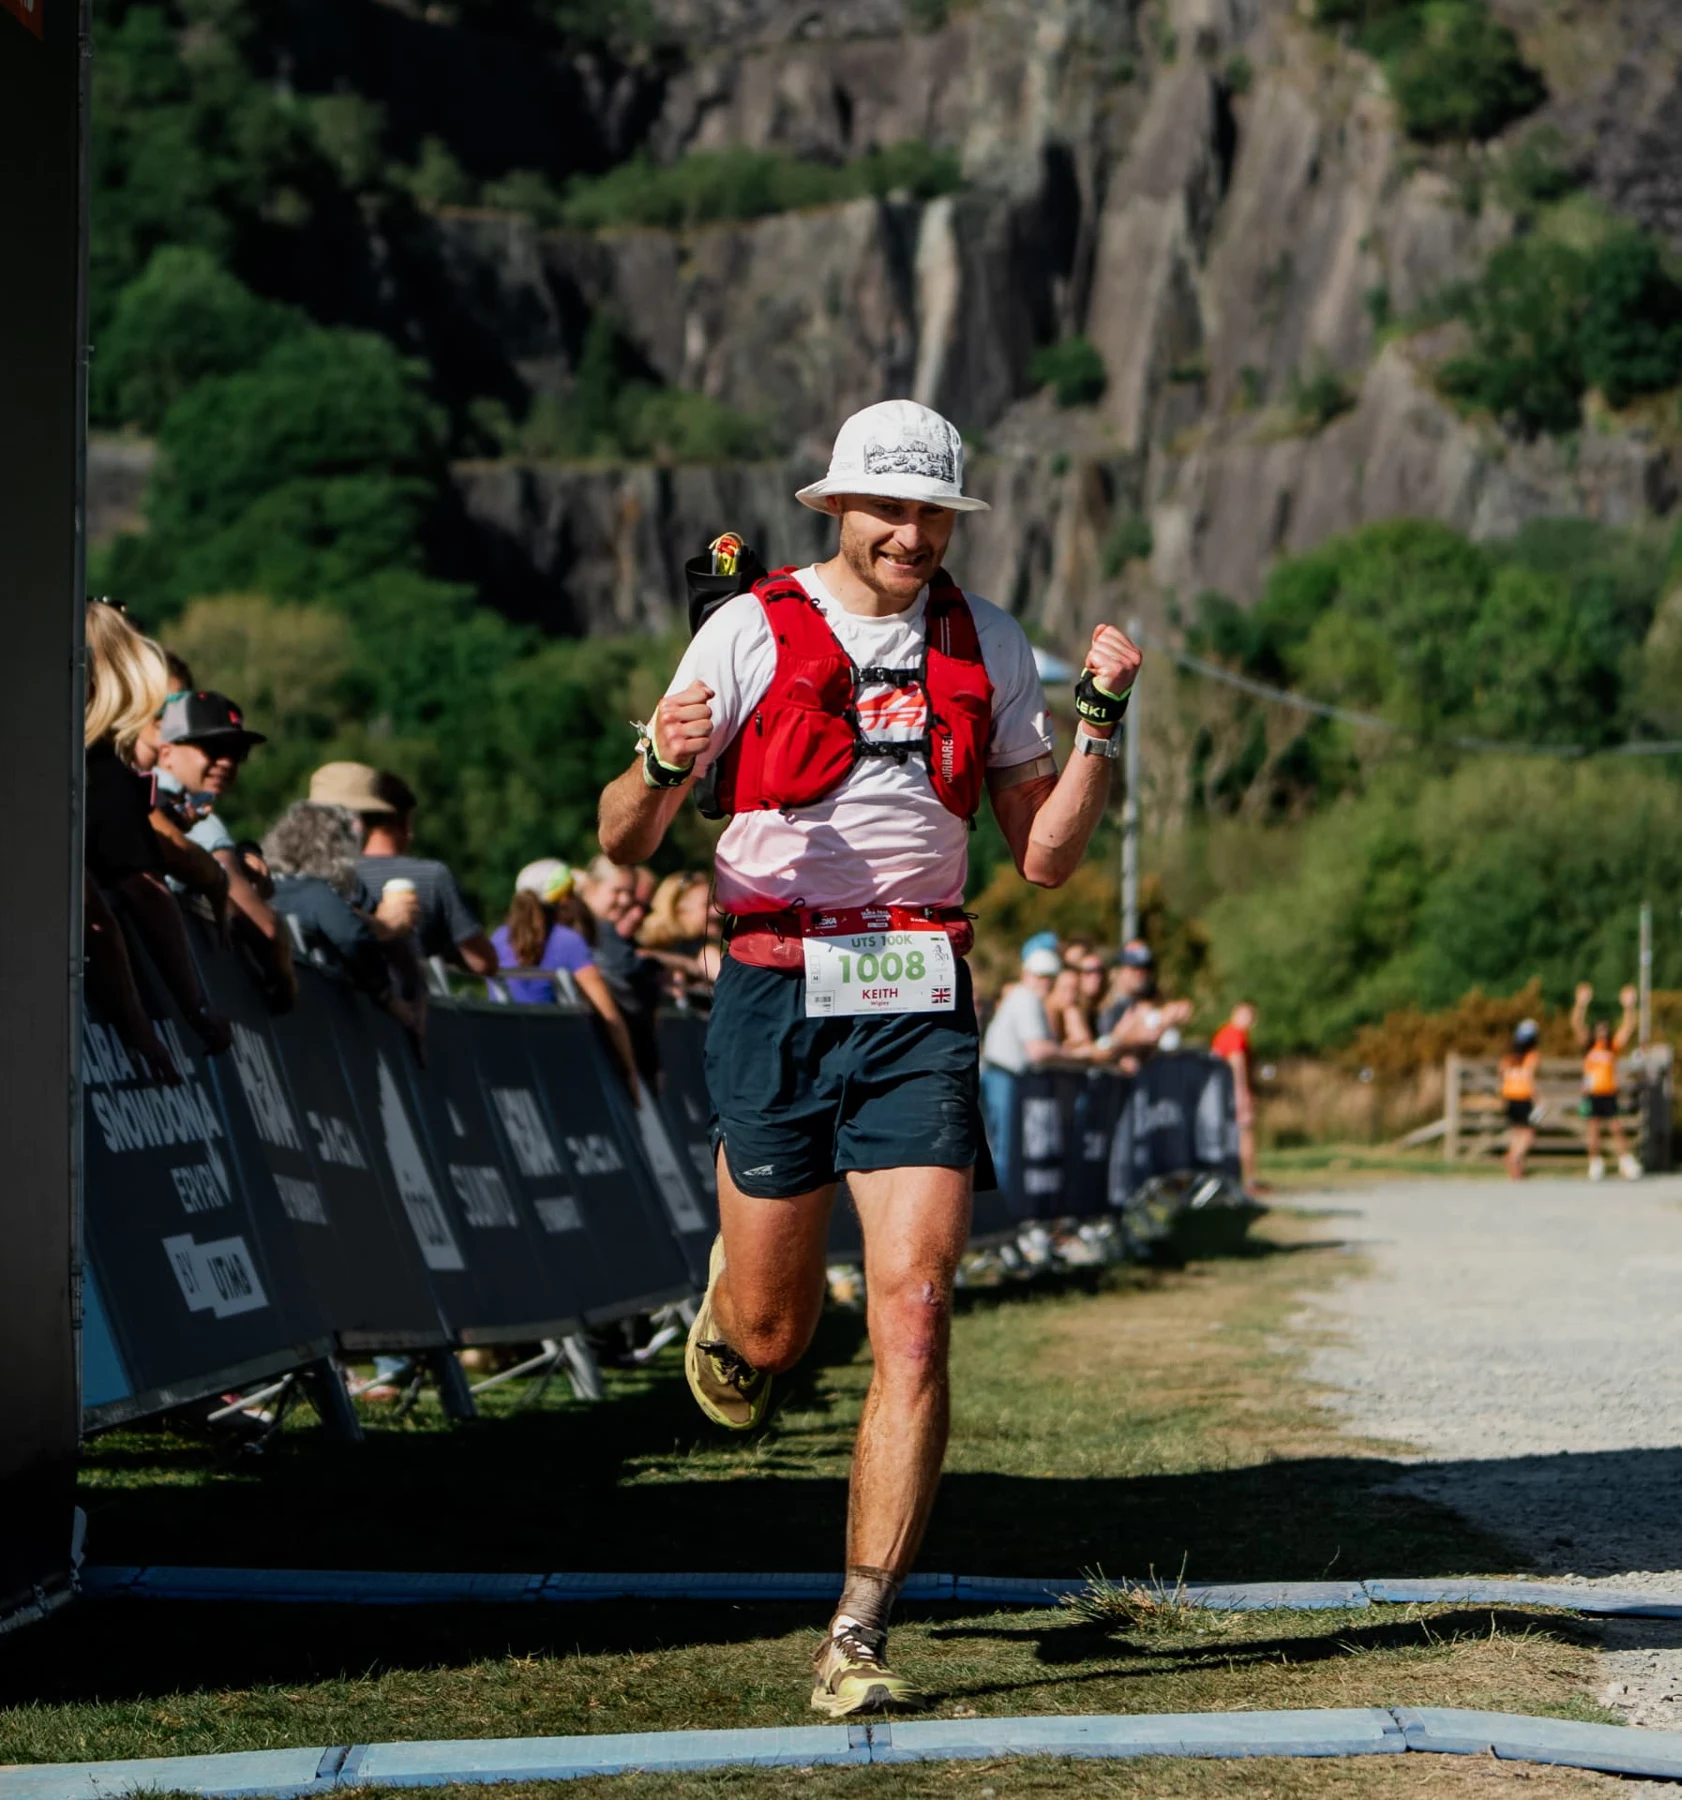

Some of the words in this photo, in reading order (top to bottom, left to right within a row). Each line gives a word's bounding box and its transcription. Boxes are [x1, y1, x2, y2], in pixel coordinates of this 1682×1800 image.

[1076, 697, 1106, 718] LEKI
[851, 935, 876, 948] UTS
[880, 934, 913, 947] 100K
[838, 950, 926, 984] 1008
[862, 987, 899, 1000] KEITH
[91, 1082, 224, 1154] SNOWDONIA
[170, 1164, 225, 1214] ERYRI
[174, 1250, 202, 1295] BY
[206, 1252, 253, 1302] UTMB
